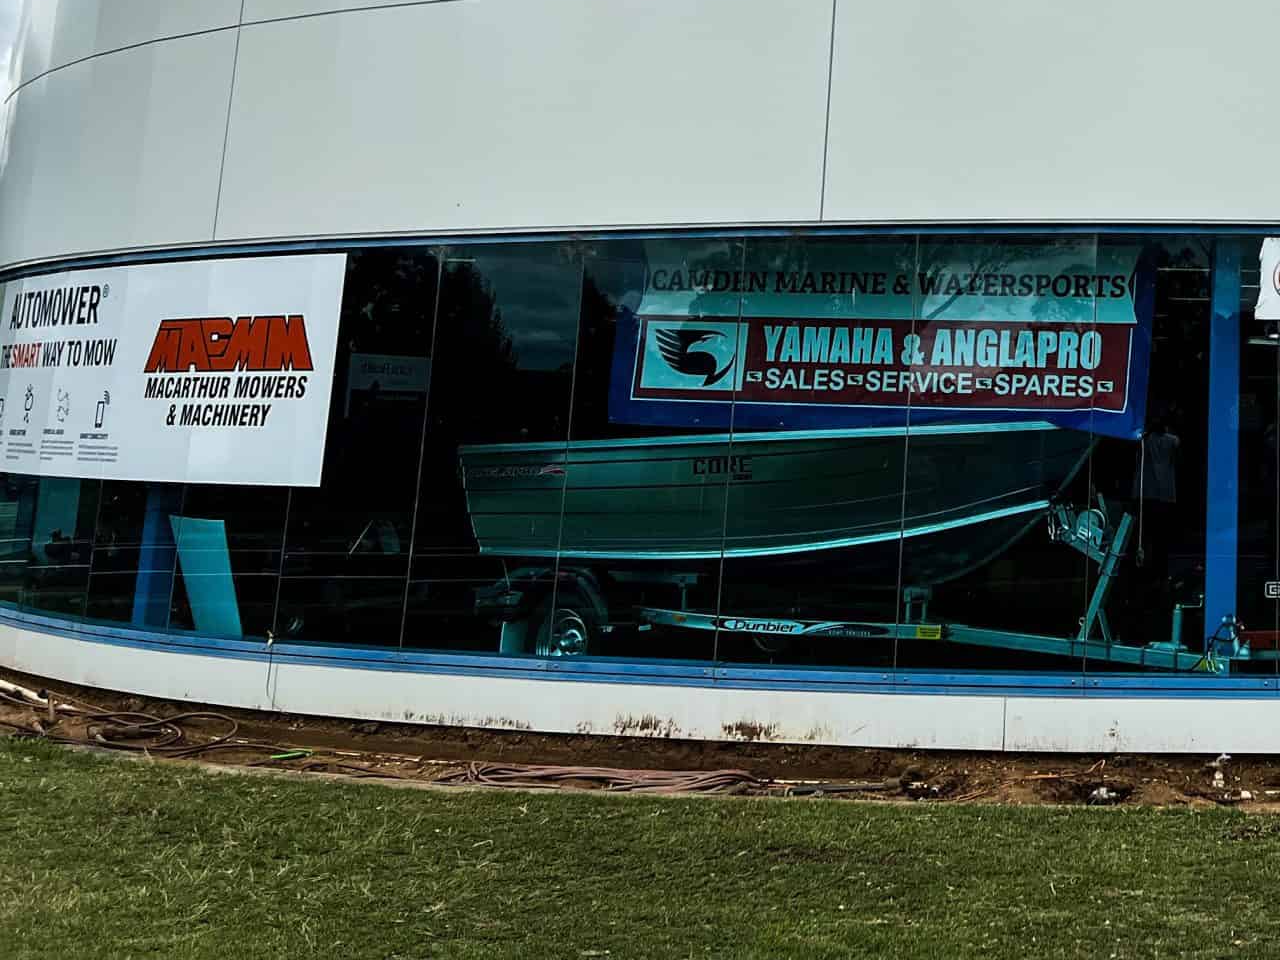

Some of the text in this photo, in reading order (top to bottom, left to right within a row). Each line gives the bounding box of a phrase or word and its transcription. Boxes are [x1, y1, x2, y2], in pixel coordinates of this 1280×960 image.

[651, 269, 1126, 298] CAMDEN MARINE & WATERSPORTS
[12, 343, 42, 368] SMART
[42, 341, 65, 367] WAY
[67, 340, 82, 367] TO
[83, 339, 117, 367] MOW
[763, 326, 1102, 370] YAMAHA & ANGLAPRO
[144, 376, 308, 399] MACARTHUR MOWERS
[765, 368, 1093, 398] SALES SERVICE SPARES
[166, 404, 271, 426] & MACHINERY
